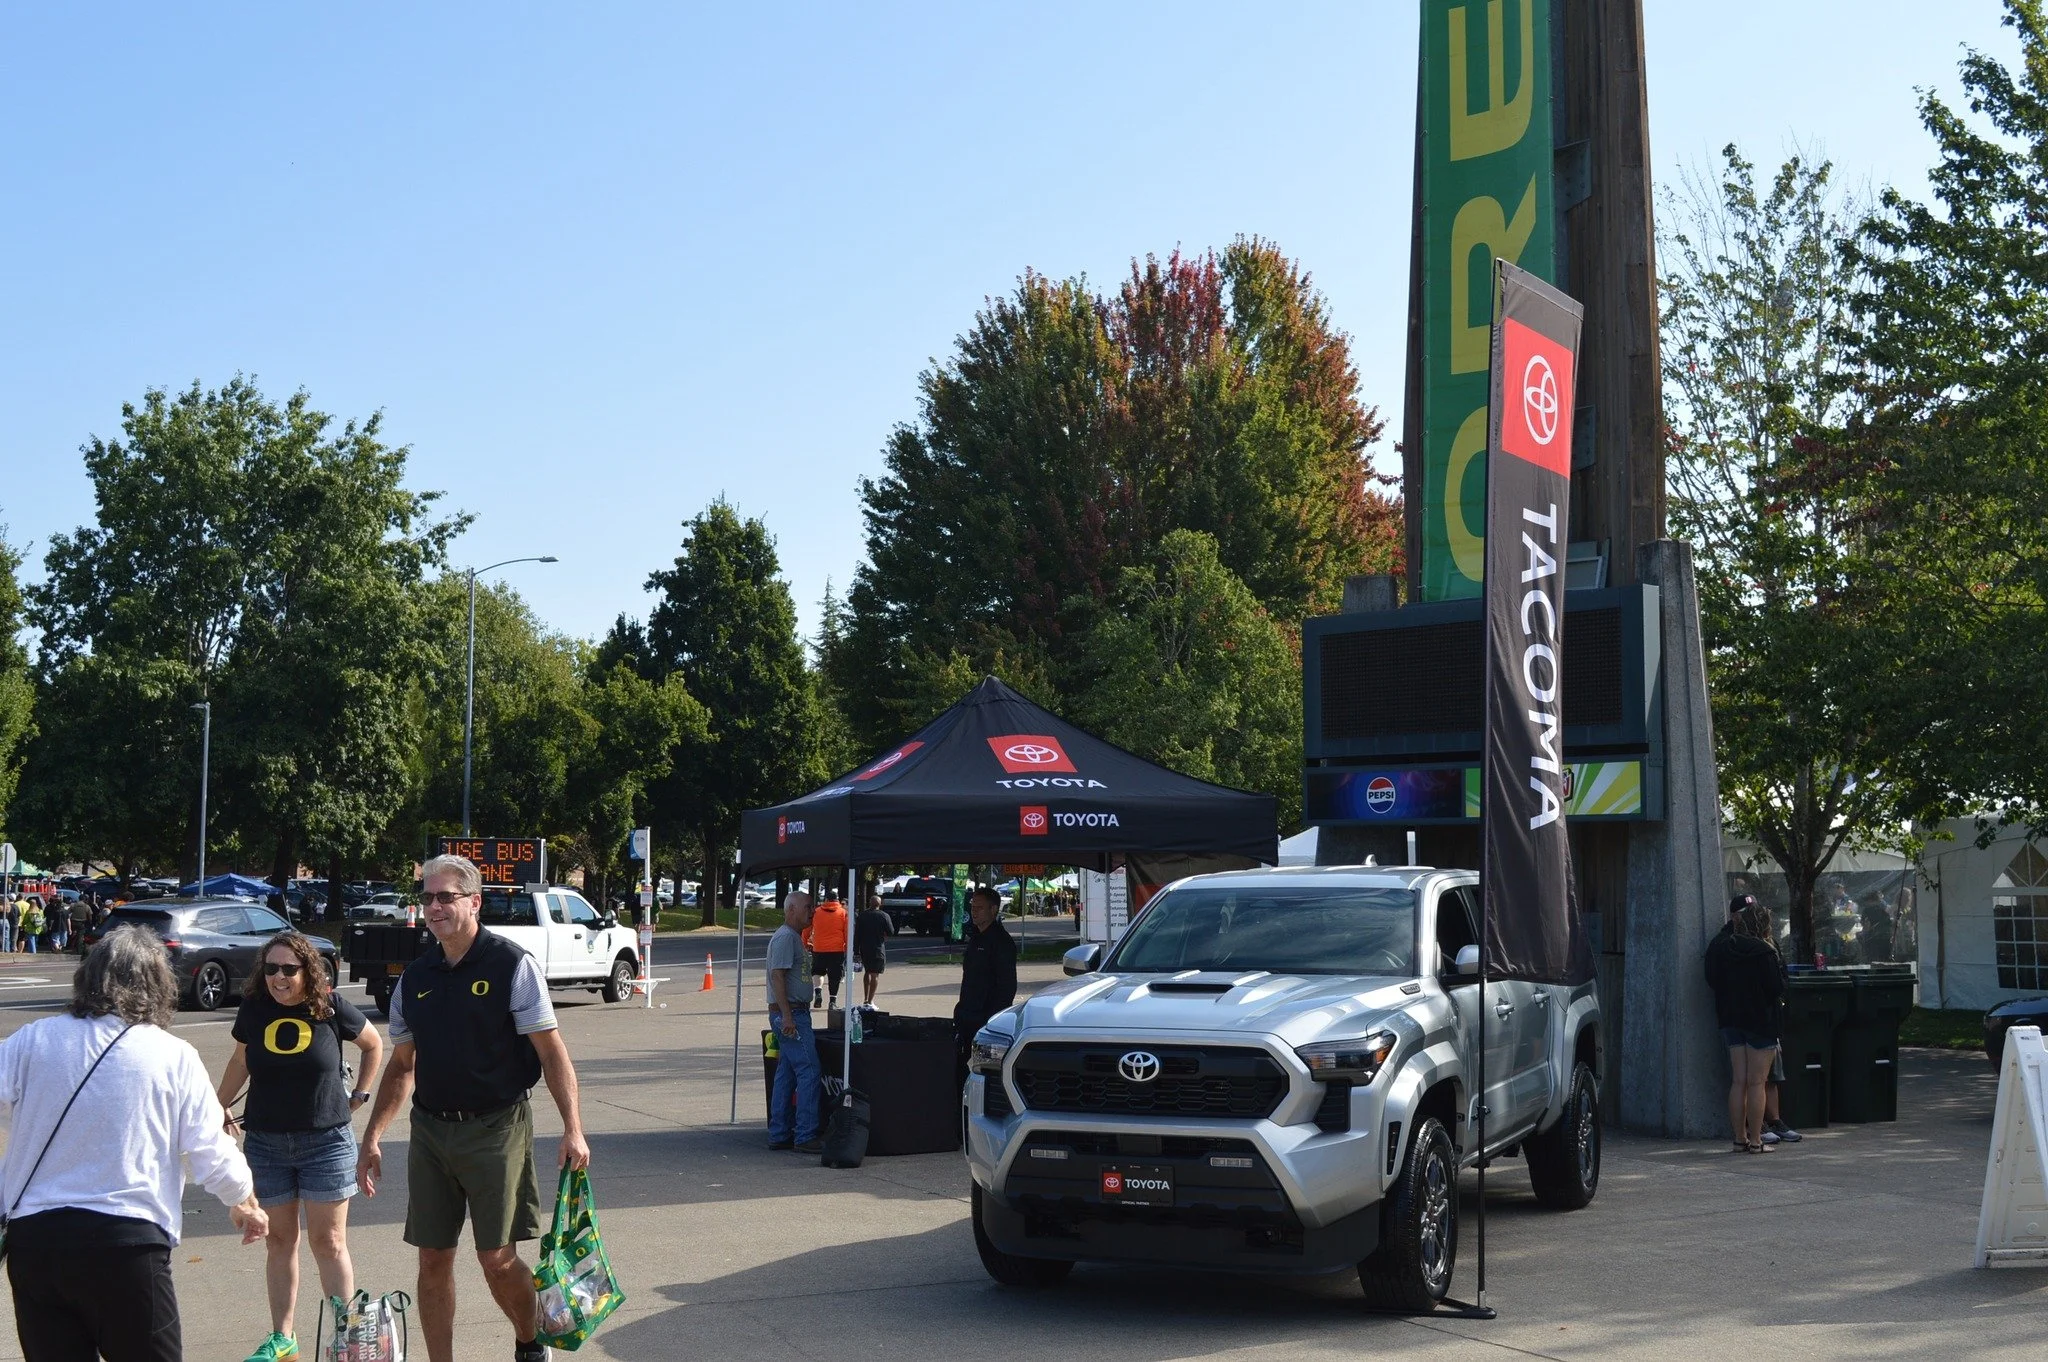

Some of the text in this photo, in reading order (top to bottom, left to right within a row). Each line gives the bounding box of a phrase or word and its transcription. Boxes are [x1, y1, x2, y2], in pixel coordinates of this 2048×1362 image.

[1520, 503, 1560, 831] TACOMA
[996, 778, 1108, 789] TOYOTA
[1368, 791, 1394, 799] PEPSI
[787, 821, 806, 834] TOYOTA
[1053, 813, 1120, 827] TOYOTA
[447, 842, 534, 861] USE BUS
[479, 864, 515, 882] ANE
[471, 980, 490, 996] O
[264, 1018, 312, 1055] O
[1125, 1179, 1170, 1190] TOYOTA
[359, 1315, 368, 1360] RIVALRY
[368, 1312, 377, 1360] ON HOLD
